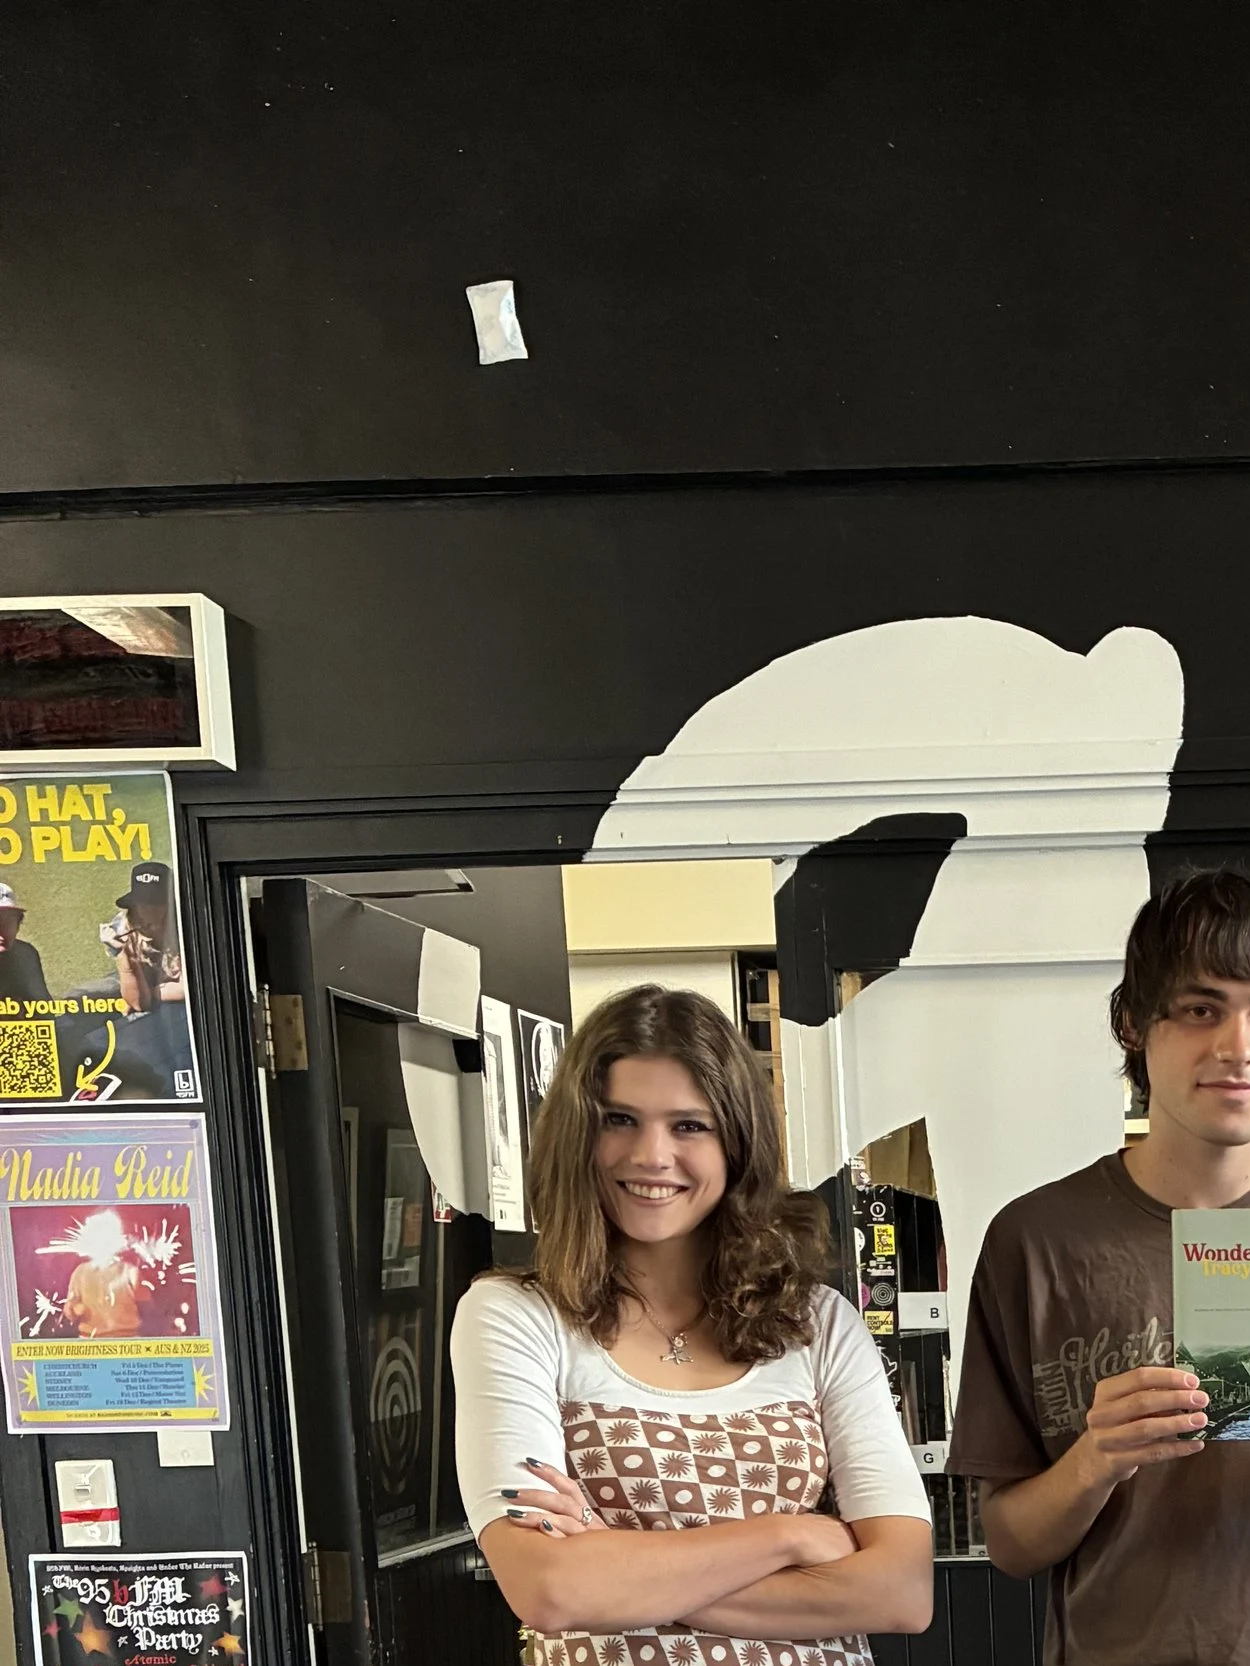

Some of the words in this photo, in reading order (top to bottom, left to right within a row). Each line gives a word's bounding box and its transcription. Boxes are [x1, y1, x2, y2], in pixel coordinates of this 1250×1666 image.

[0, 786, 17, 824] O
[26, 784, 126, 827] HAT,
[0, 827, 22, 865] O
[31, 824, 152, 863] PLAY!
[0, 996, 20, 1015] ab
[25, 998, 79, 1018] yours
[83, 995, 128, 1013] here
[0, 1148, 100, 1201] Nadia
[114, 1145, 193, 1199] Reid
[930, 1307, 939, 1318] B
[16, 1346, 44, 1357] ENTER
[45, 1345, 65, 1356] NOW
[66, 1344, 118, 1356] BRIGHTNESS
[120, 1344, 142, 1355] TOUR
[154, 1343, 172, 1354] AUS
[180, 1343, 192, 1354] NZ
[193, 1343, 210, 1354] 2025
[1060, 1317, 1173, 1383] Harle
[923, 1452, 934, 1464] G
[52, 1574, 79, 1591] The
[103, 1603, 220, 1629] Christmas
[133, 1627, 203, 1655] Party
[124, 1653, 176, 1666] Atomic
